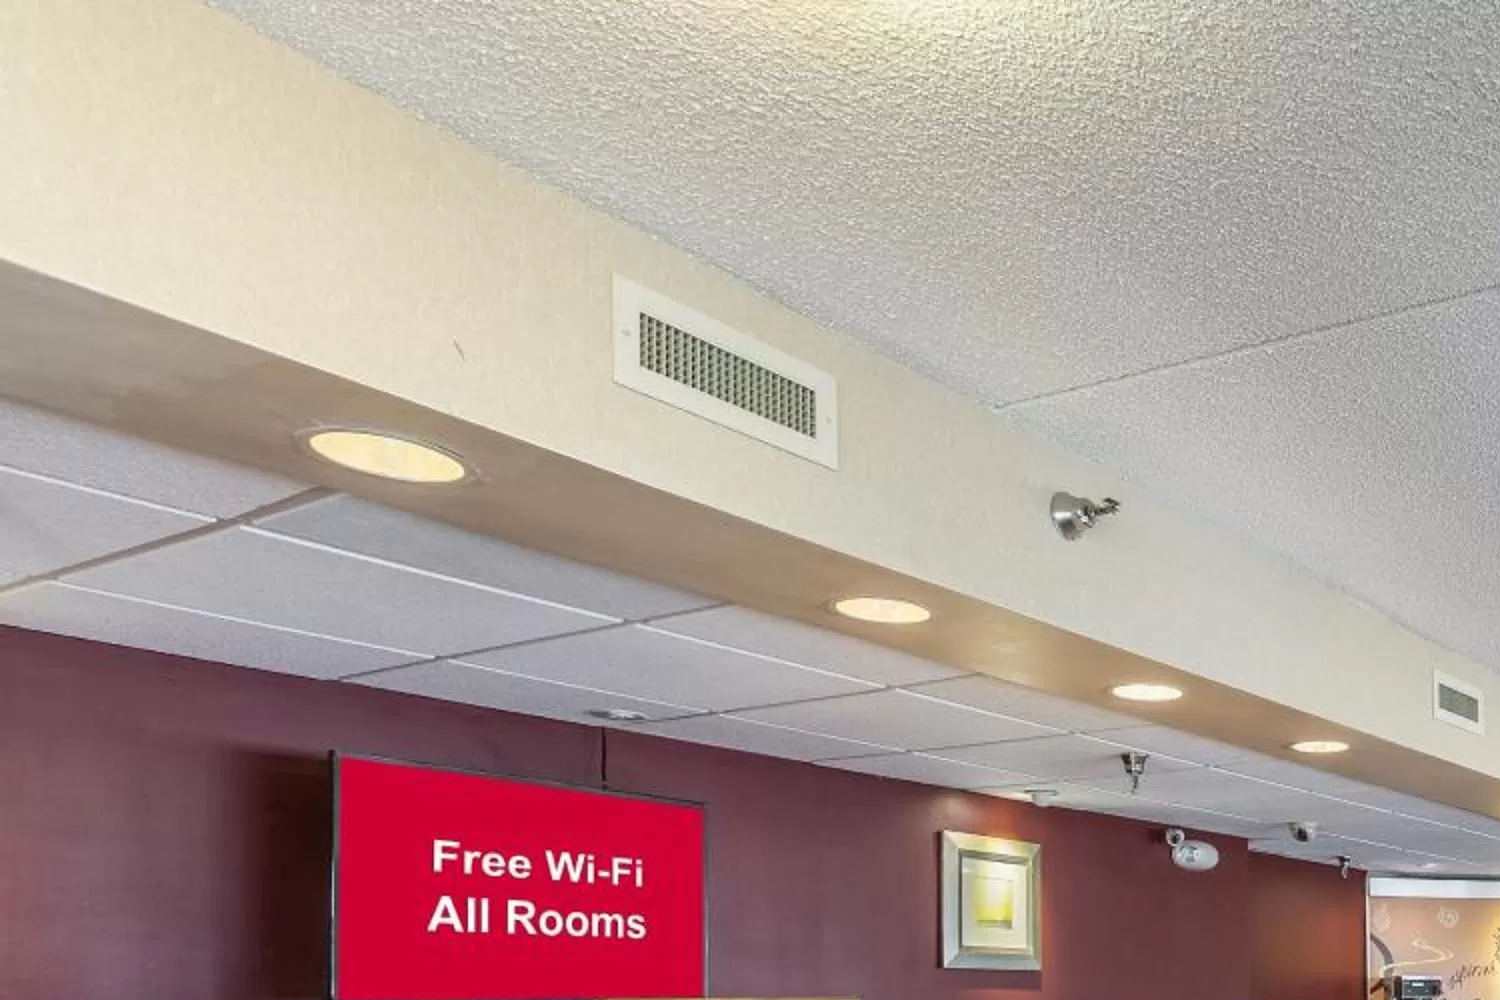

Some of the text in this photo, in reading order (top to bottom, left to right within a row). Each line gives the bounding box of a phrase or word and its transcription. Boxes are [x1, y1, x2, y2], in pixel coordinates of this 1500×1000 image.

[432, 838, 645, 888] Free Wi-Fi
[427, 895, 647, 940] All Rooms
